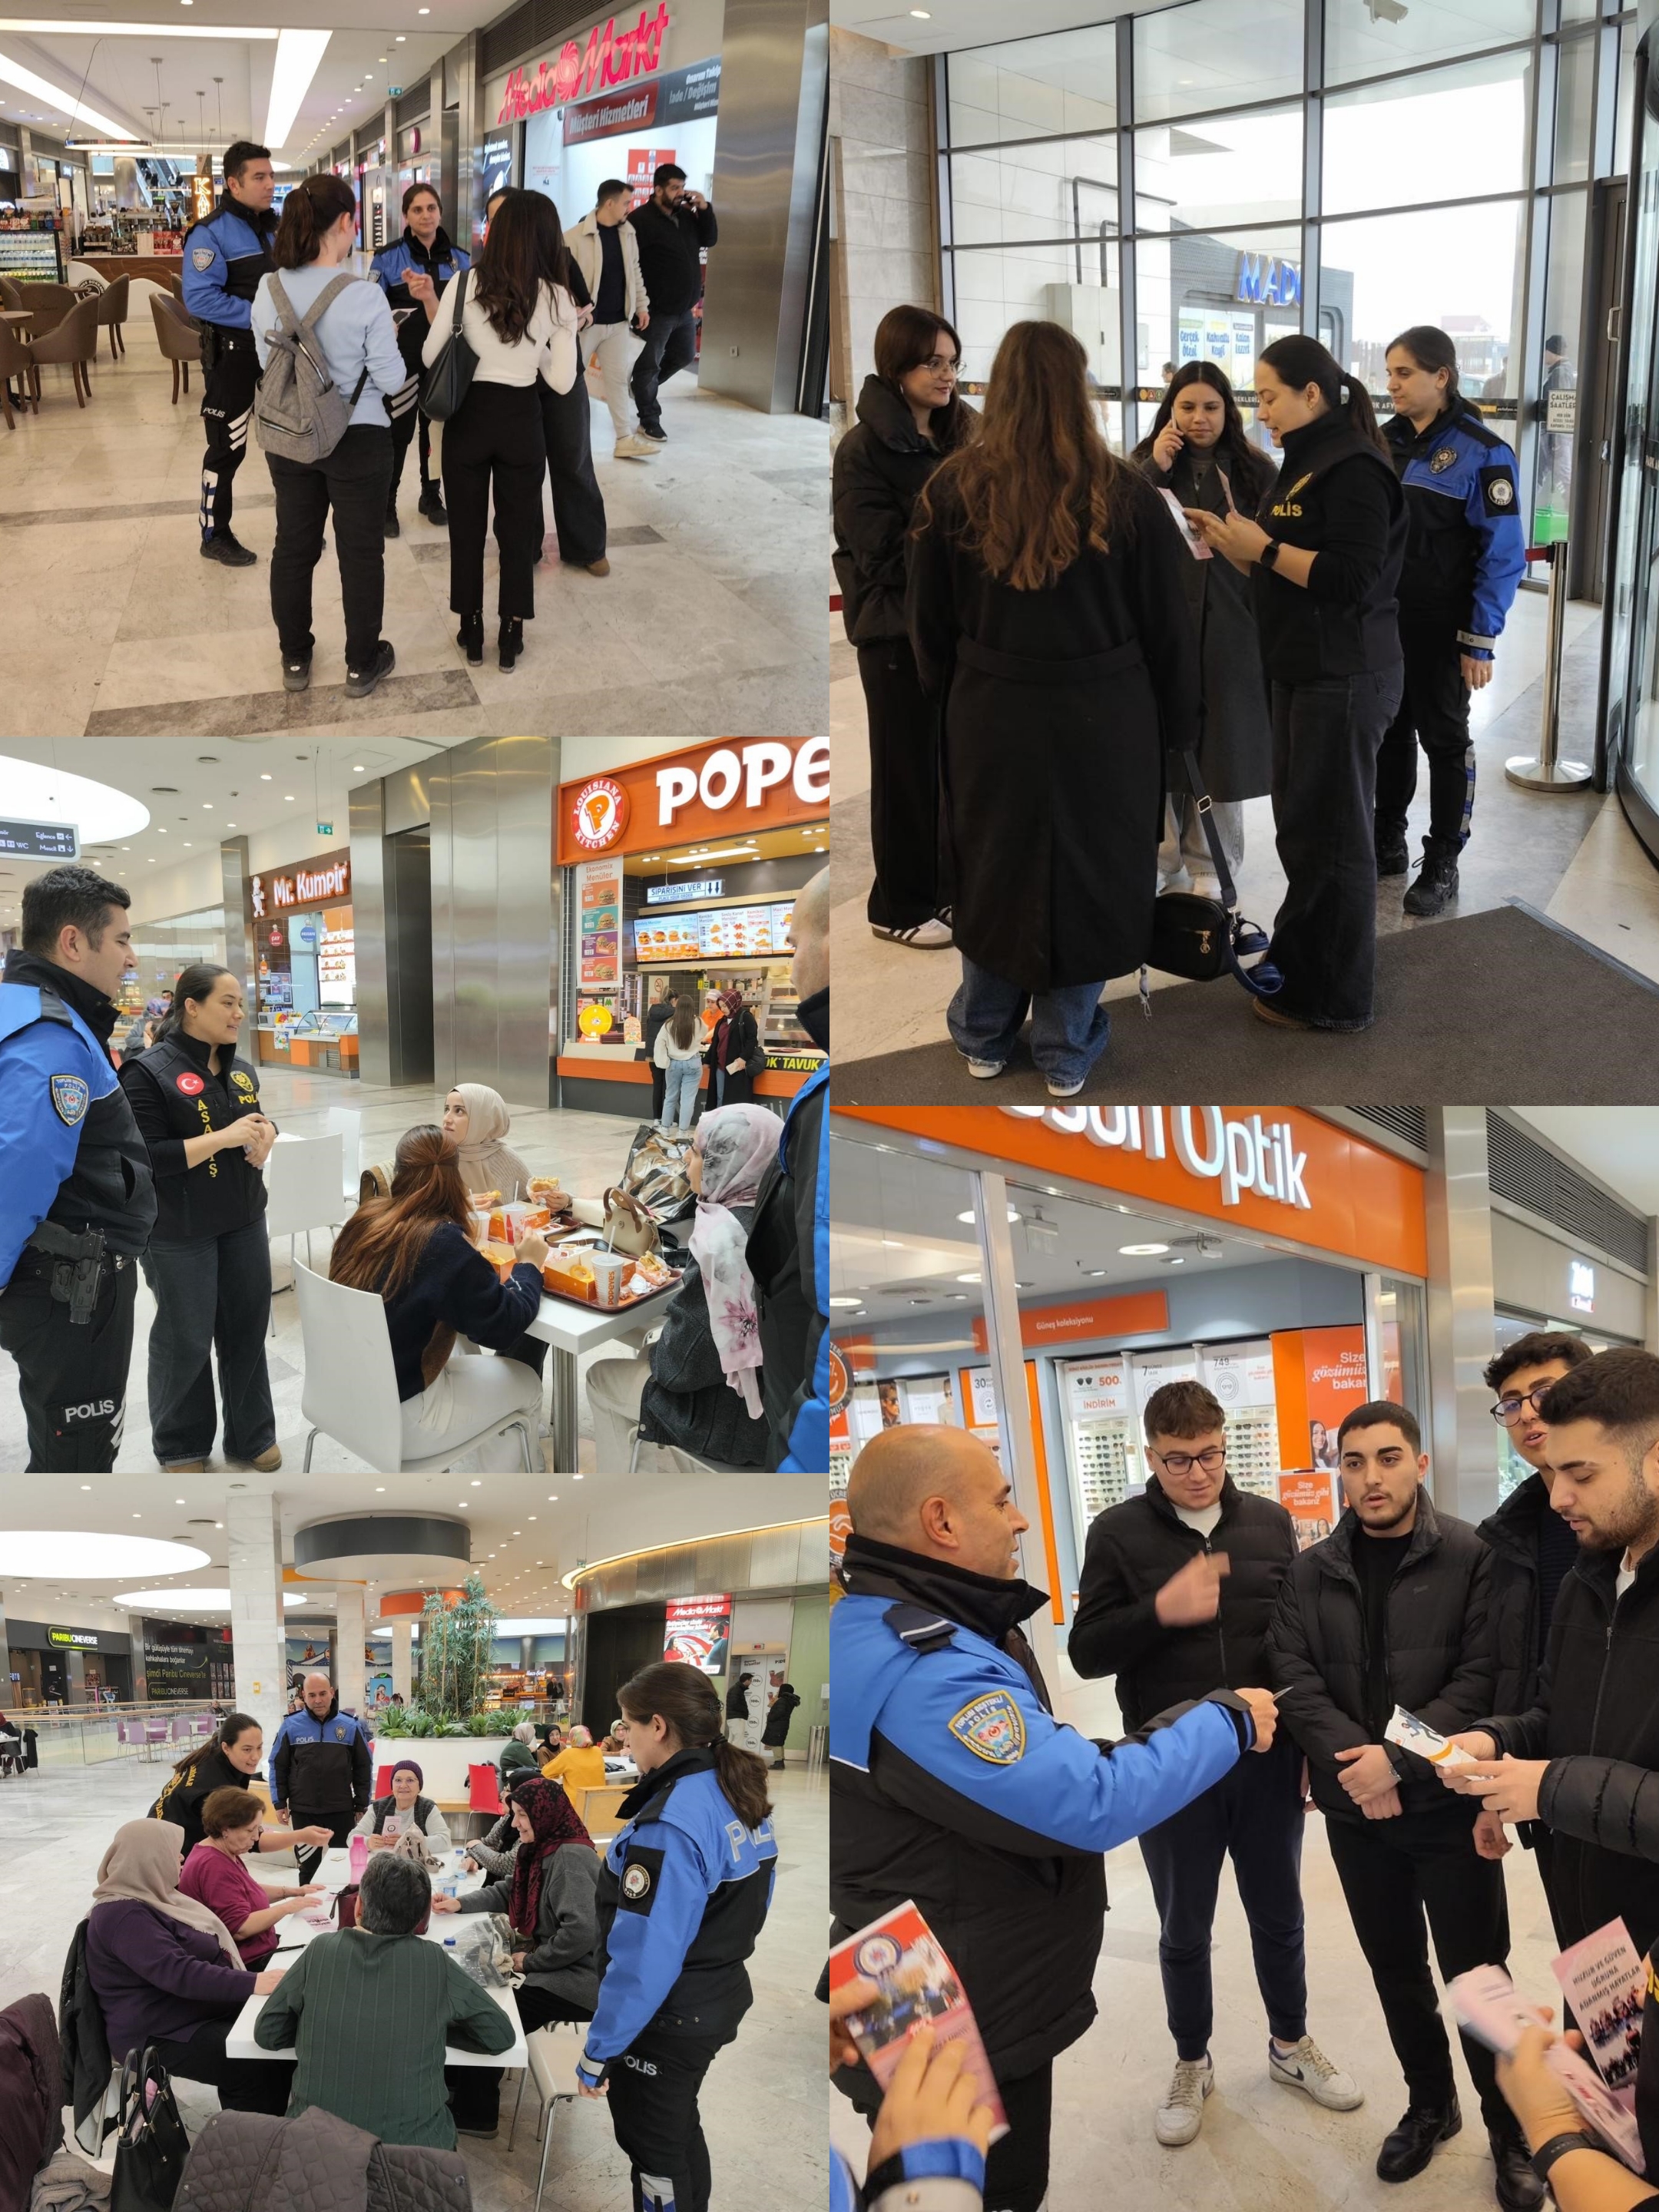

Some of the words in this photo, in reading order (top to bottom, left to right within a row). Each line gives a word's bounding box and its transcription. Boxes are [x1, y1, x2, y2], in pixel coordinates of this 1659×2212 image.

[498, 61, 558, 125] Media
[571, 2, 669, 98] Markt
[569, 108, 599, 135] Müşteri
[599, 94, 649, 127] Hizmetleri
[573, 780, 622, 816] LOUISIANA
[575, 820, 620, 849] KITCHEN
[586, 863, 614, 874] Ekonomix
[586, 872, 614, 882] Menüler
[273, 876, 295, 906] Mr.
[296, 862, 347, 902] Kumpir
[687, 882, 702, 892] VER
[783, 1058, 820, 1071] TAVUK
[1084, 1399, 1116, 1409] İNDİRİM
[1594, 1960, 1604, 1969] VE
[1609, 1965, 1641, 1991] HAYATLAR
[624, 2055, 657, 2076] OLİS
